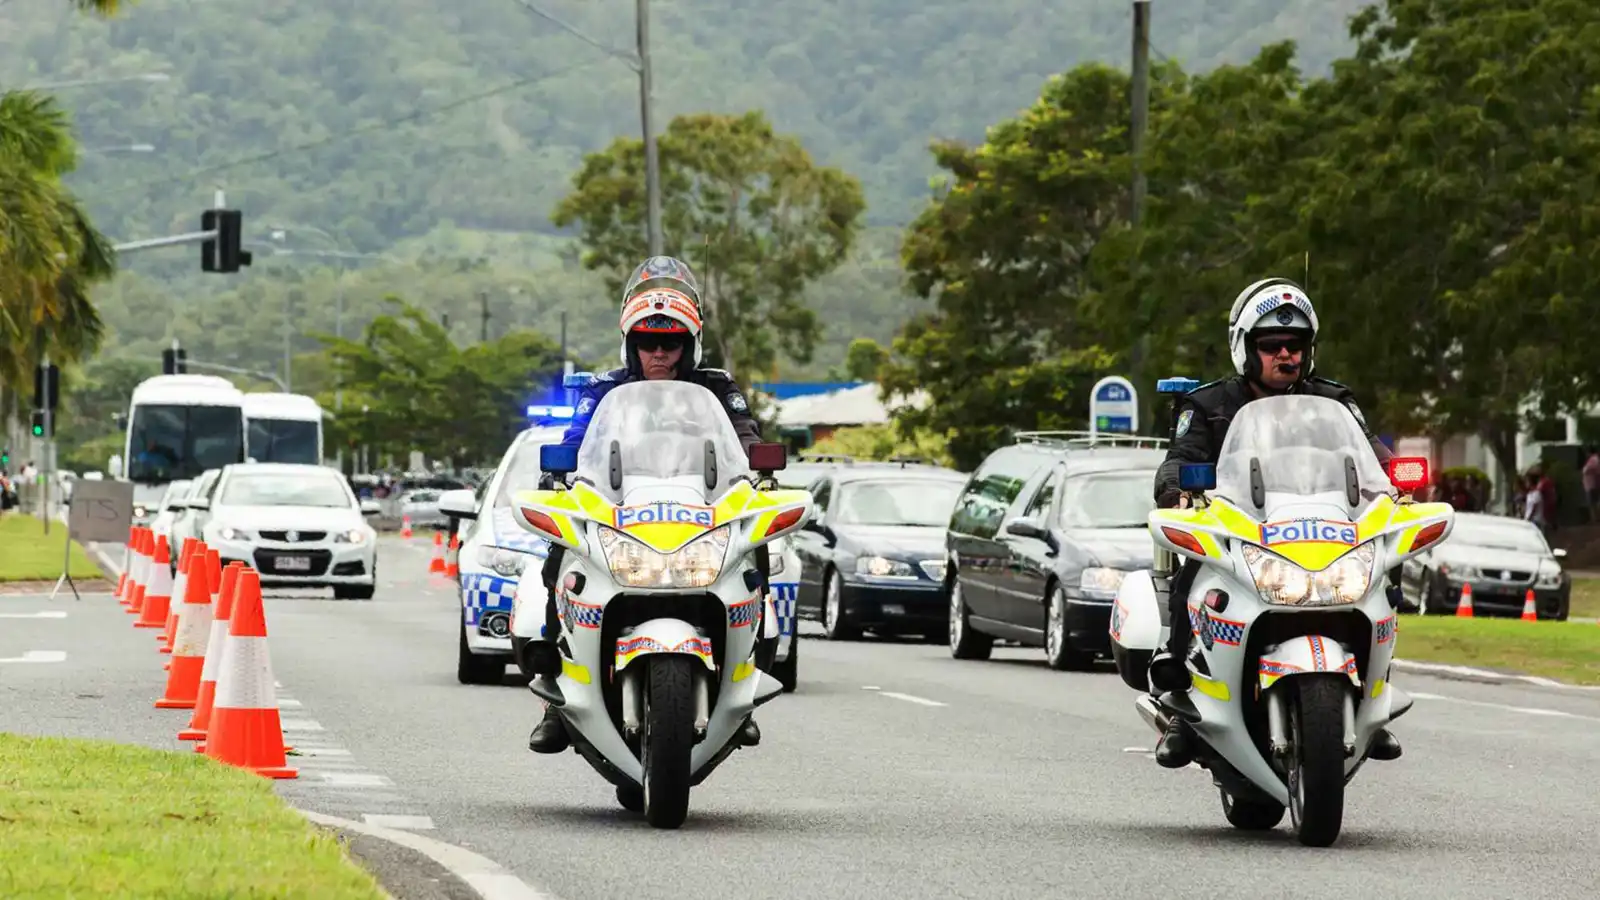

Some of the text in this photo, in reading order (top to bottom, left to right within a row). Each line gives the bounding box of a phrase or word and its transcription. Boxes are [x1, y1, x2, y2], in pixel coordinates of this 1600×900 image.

[76, 498, 119, 522] TS
[617, 502, 711, 527] Police
[1262, 519, 1355, 544] Police
